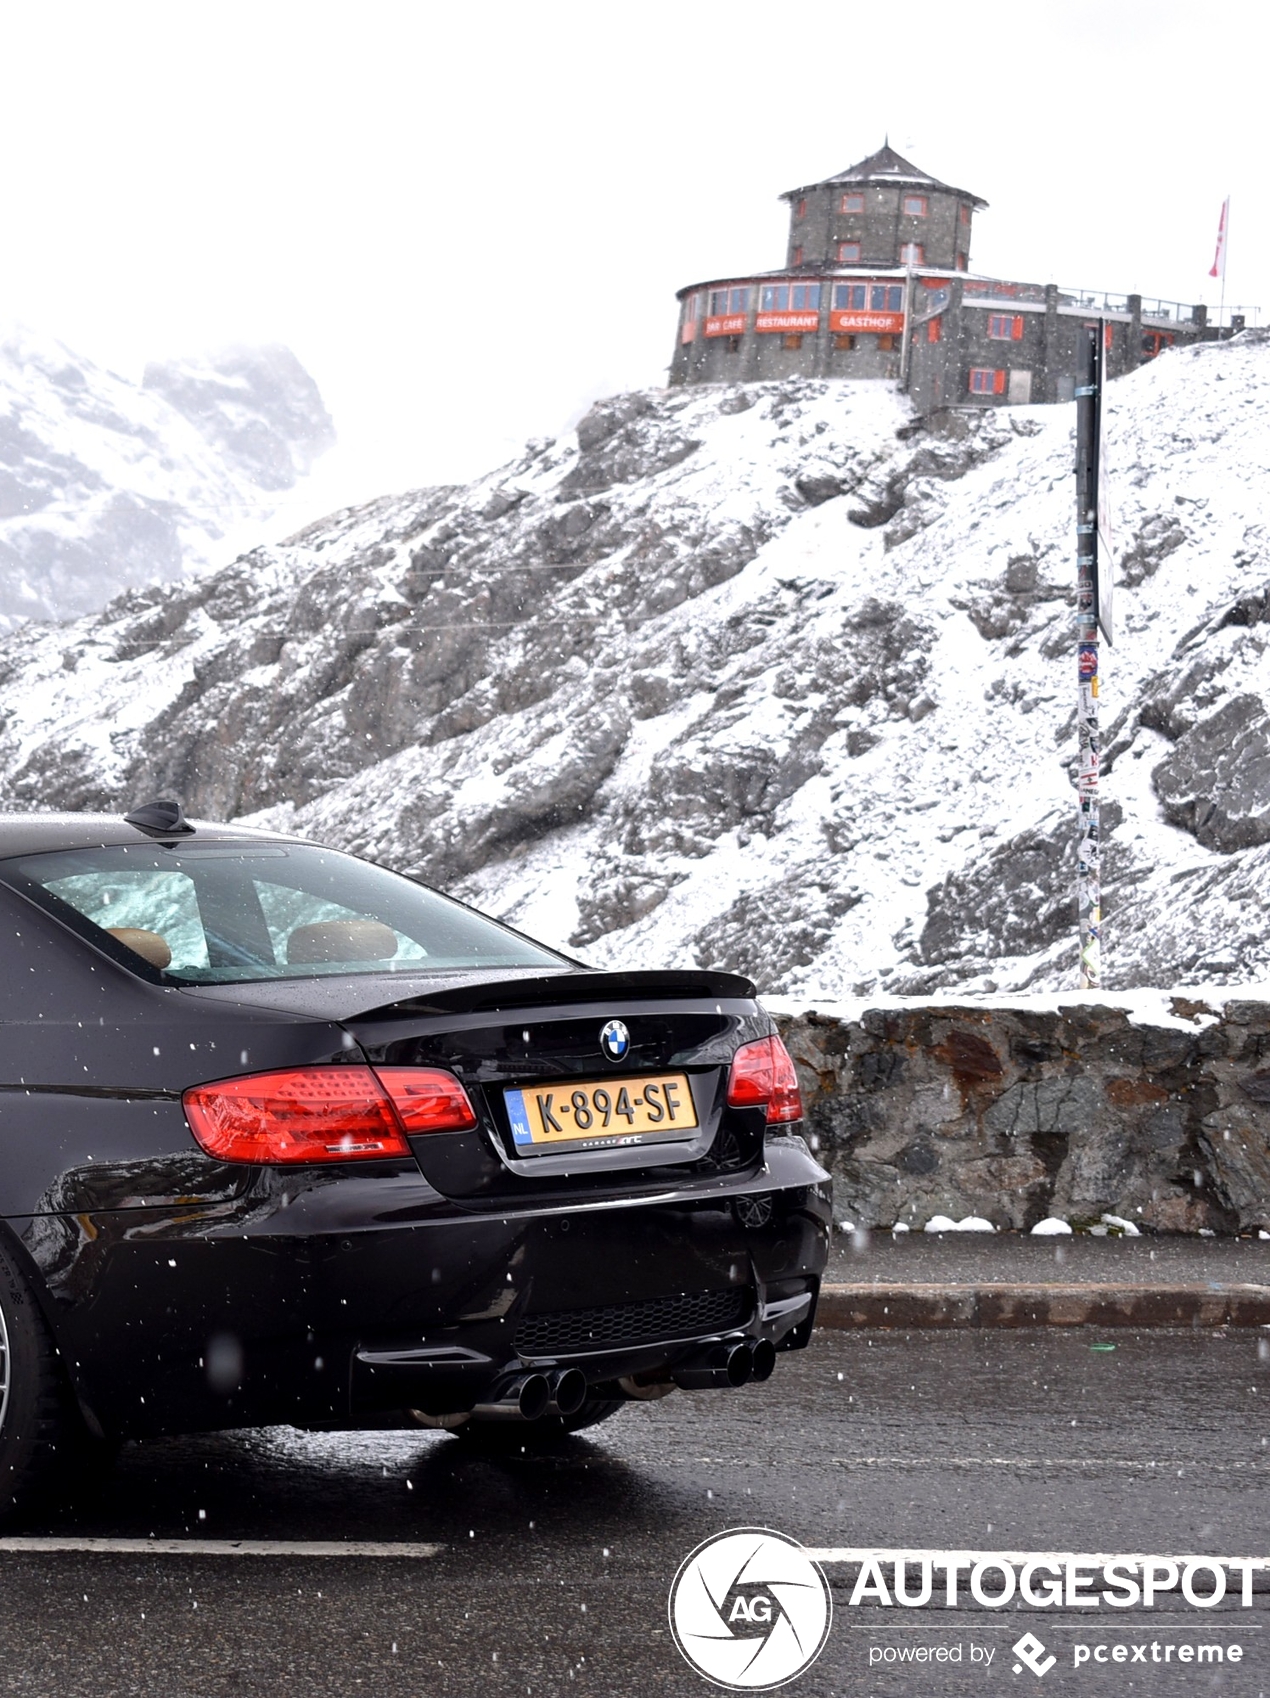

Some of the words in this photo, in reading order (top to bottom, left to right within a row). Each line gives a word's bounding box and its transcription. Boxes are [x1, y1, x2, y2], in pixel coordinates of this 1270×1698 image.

[757, 316, 818, 328] RESTAURANT
[840, 316, 893, 328] GASTHOF
[536, 1082, 681, 1133] K-894-SF
[513, 1123, 528, 1136] NL
